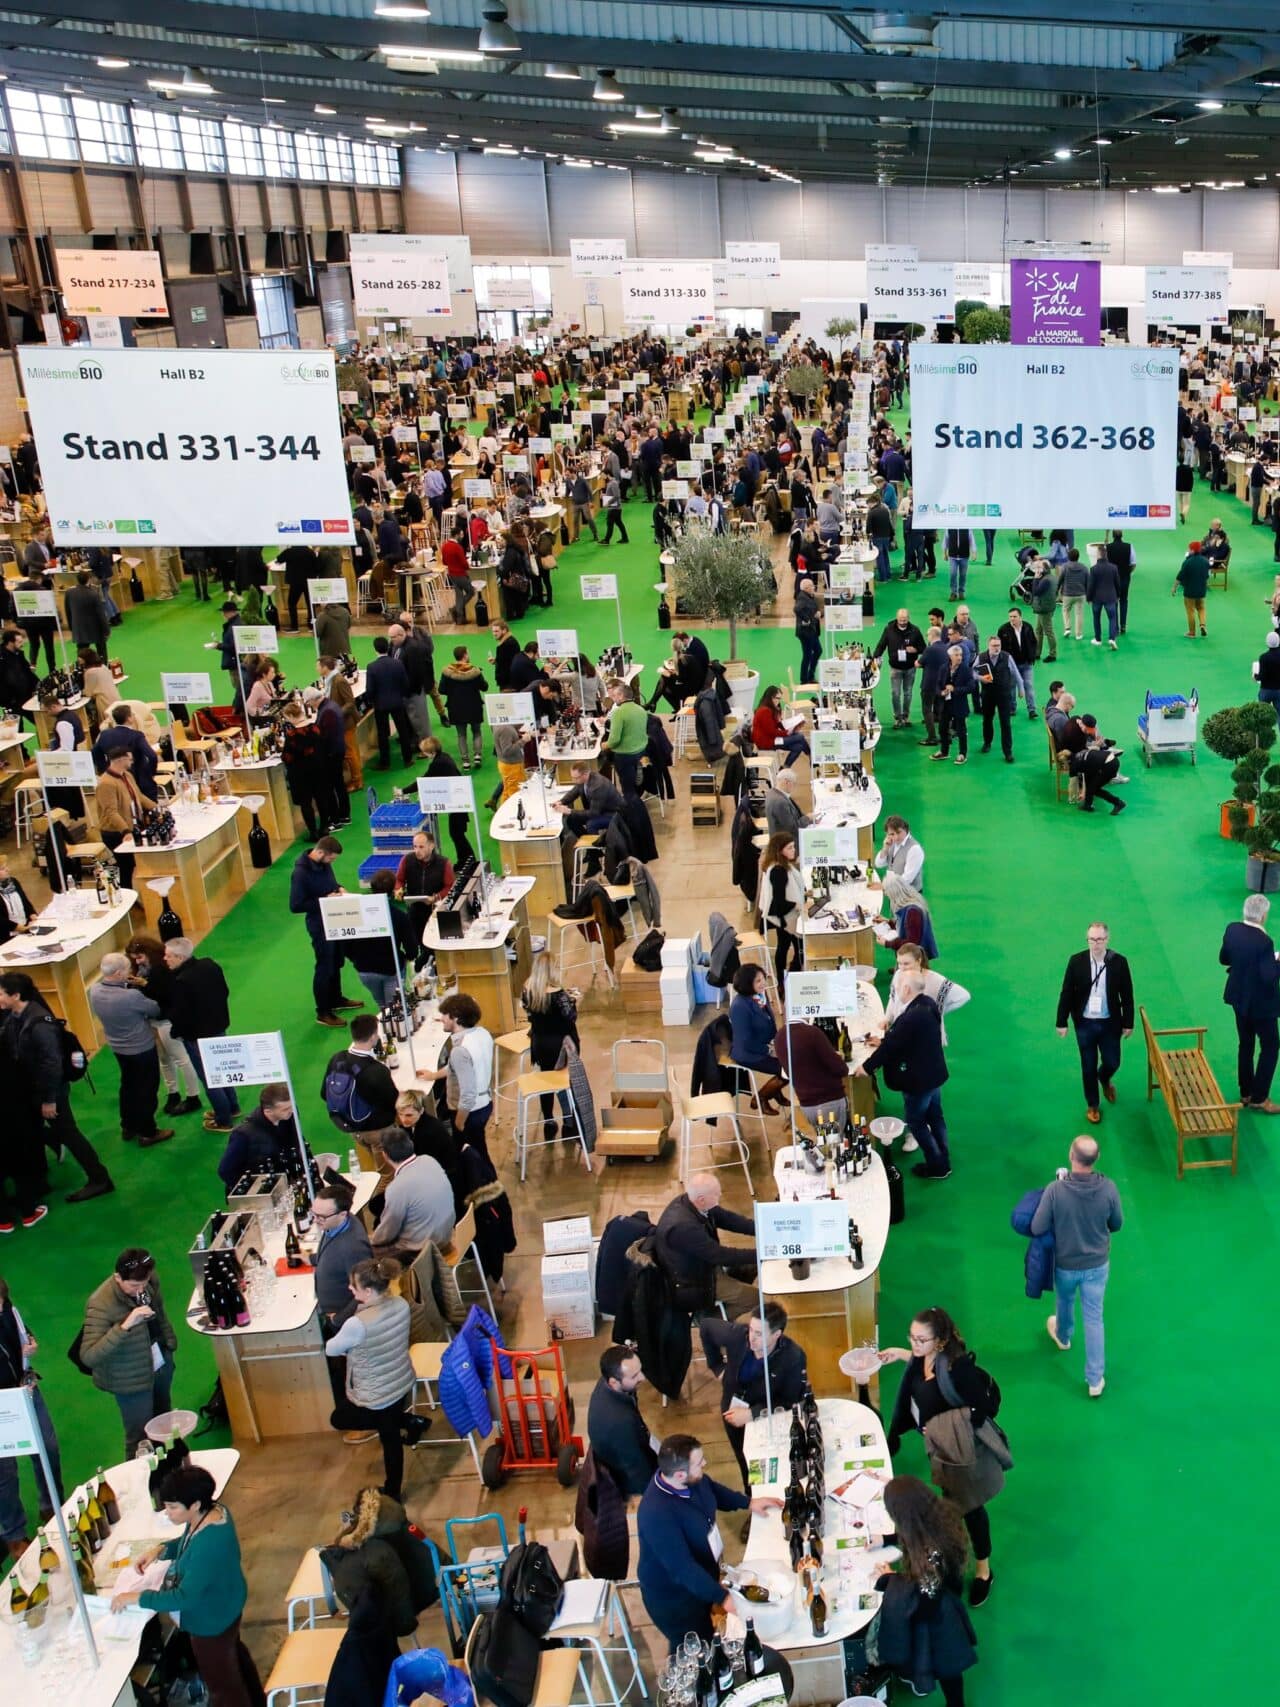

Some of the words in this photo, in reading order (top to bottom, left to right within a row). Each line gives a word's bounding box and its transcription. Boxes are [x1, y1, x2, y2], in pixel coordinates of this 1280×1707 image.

[70, 277, 105, 288] Stand
[108, 278, 156, 288] 217-234
[361, 279, 394, 290] Stand
[397, 280, 442, 290] 265-282
[1052, 272, 1079, 293] Sud
[630, 287, 661, 298] Stand
[663, 288, 707, 298] 313-330
[874, 286, 904, 296] Stand
[906, 287, 947, 297] 353-361
[1152, 289, 1181, 300] Stand
[1182, 290, 1222, 300] 377-385
[1050, 292, 1070, 305] de
[1032, 295, 1086, 323] France
[1046, 330, 1078, 338] MARQUE
[1039, 336, 1084, 344] L'OCCITANIE
[160, 368, 186, 380] Hall
[189, 369, 205, 380] B2
[1026, 364, 1048, 375] Hall
[1051, 365, 1065, 375] B2
[934, 422, 1023, 449] Stand
[1032, 425, 1156, 450] 362-368
[63, 432, 169, 461] Stand
[178, 434, 321, 461] 331-344
[816, 856, 828, 864] 366
[341, 928, 356, 936] 340
[805, 1006, 820, 1014] 367
[226, 1072, 244, 1083] 342
[782, 1244, 802, 1255] 368
